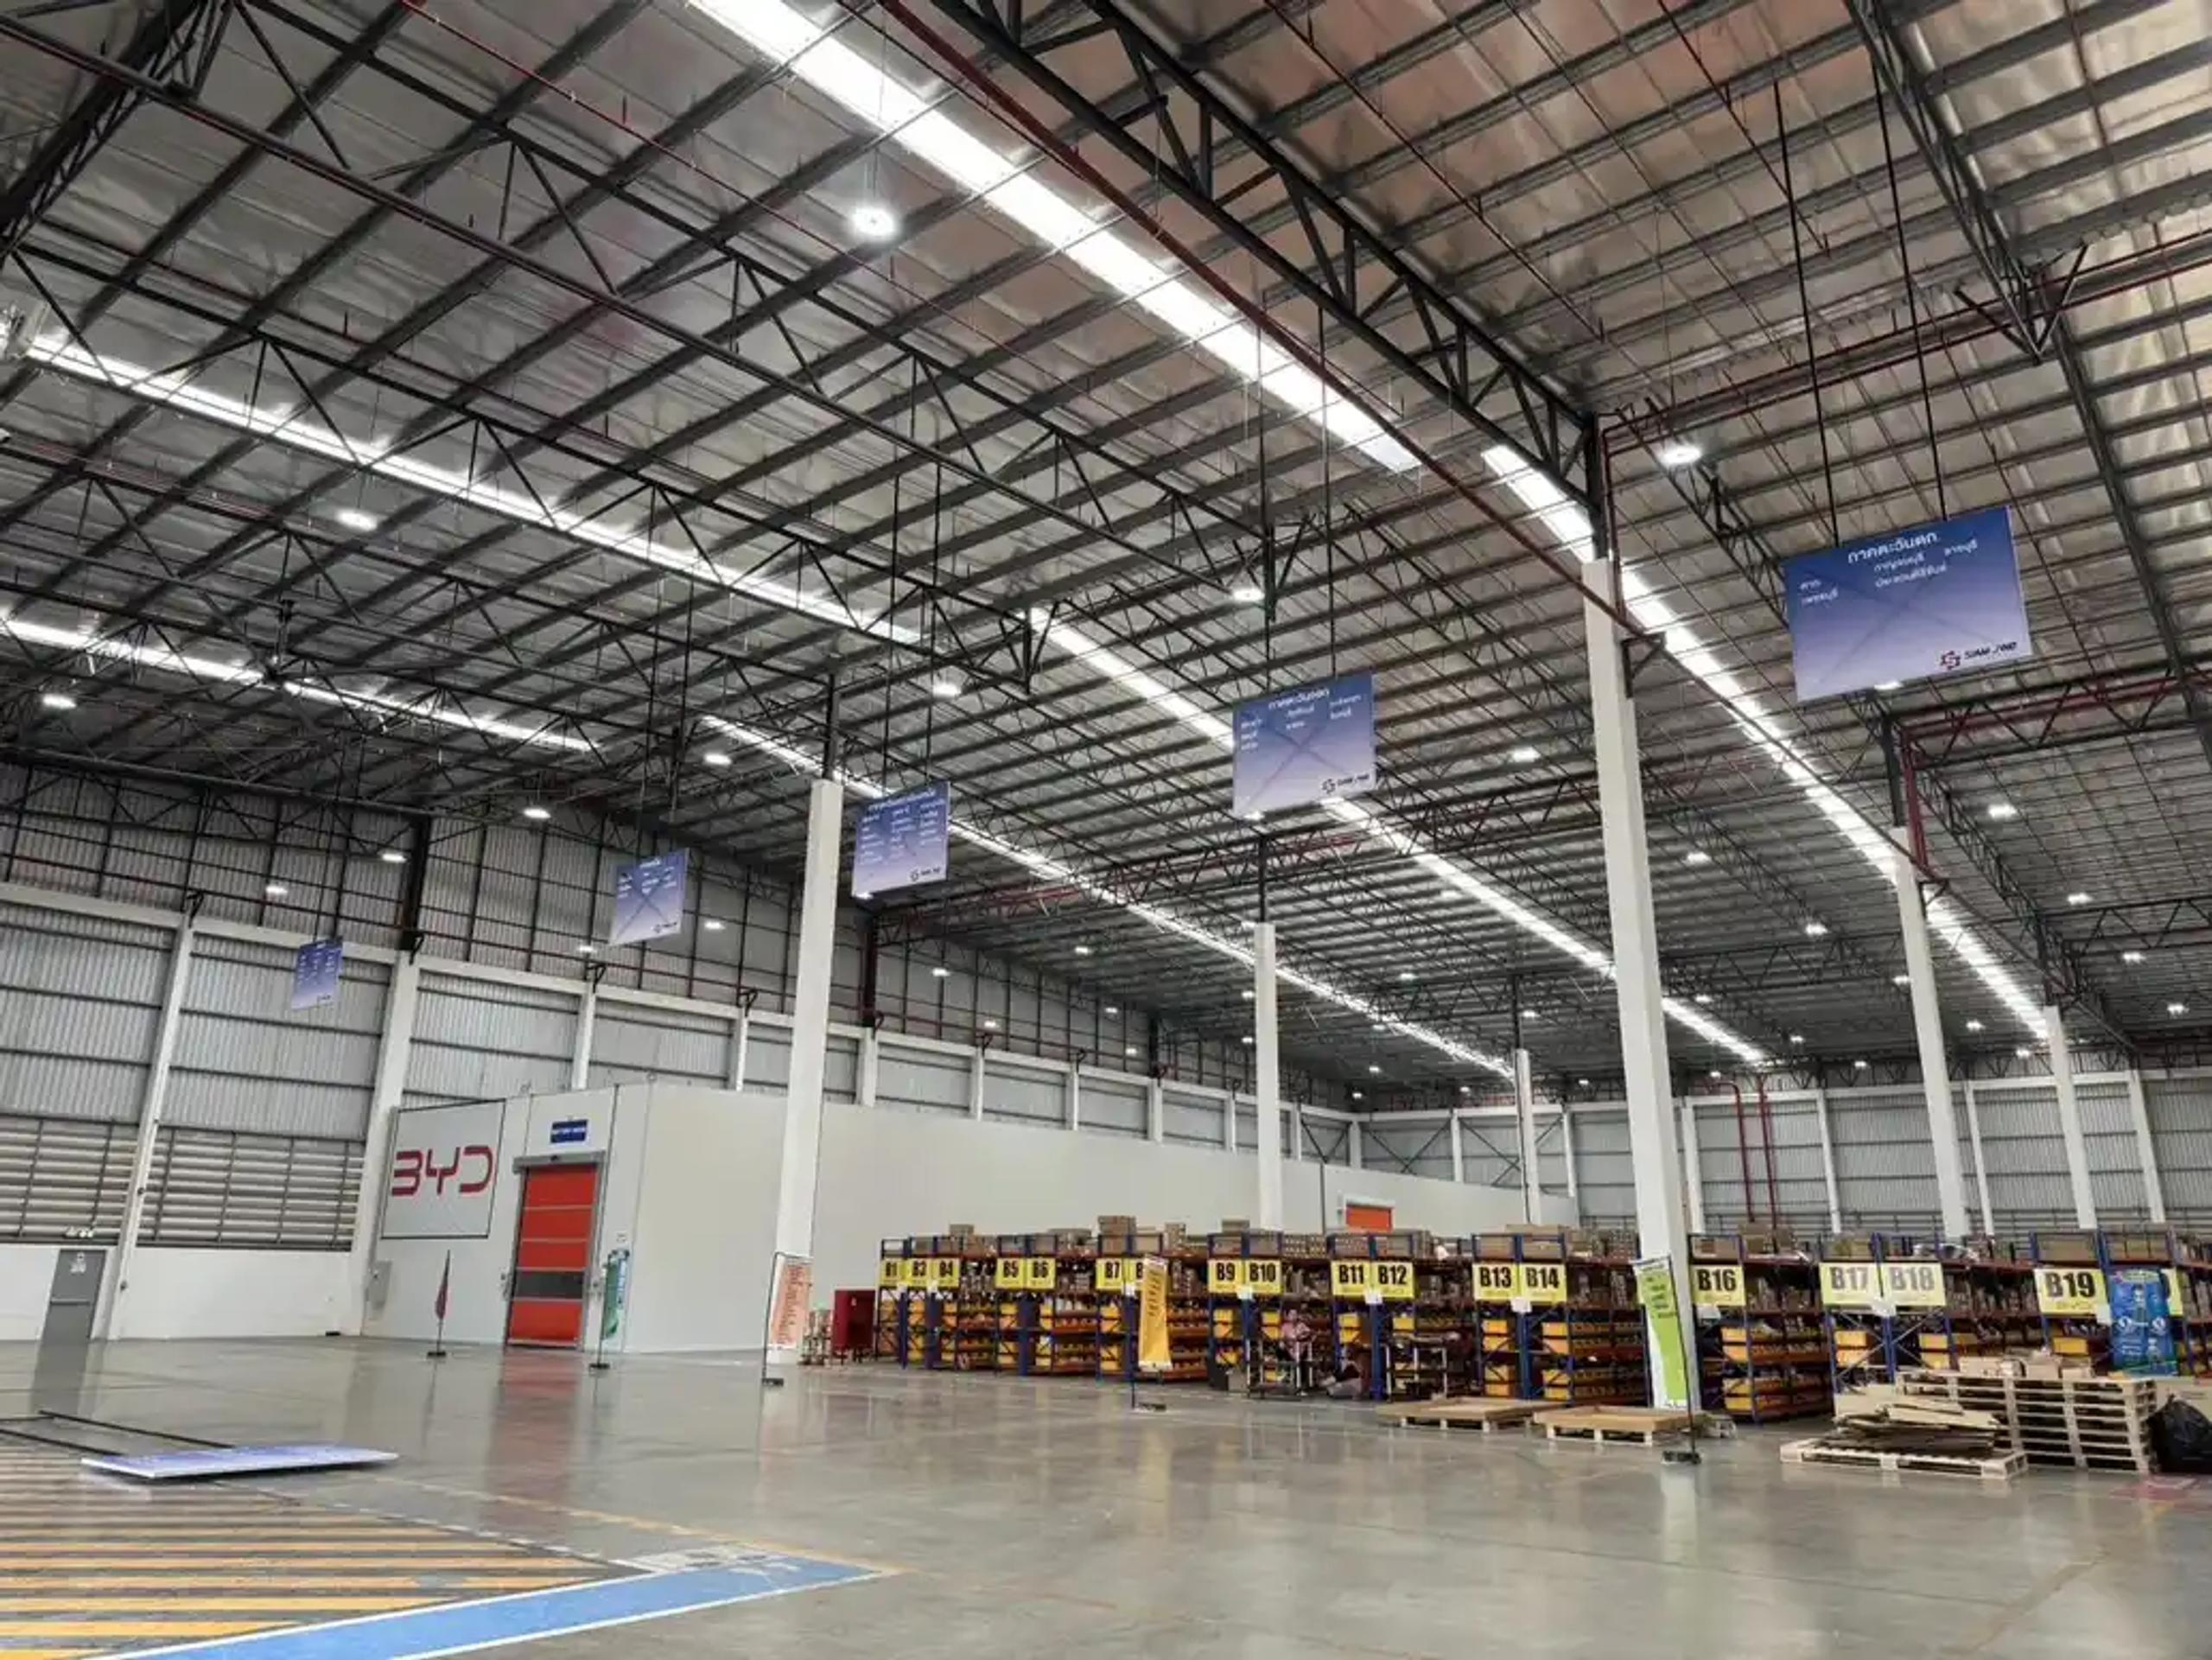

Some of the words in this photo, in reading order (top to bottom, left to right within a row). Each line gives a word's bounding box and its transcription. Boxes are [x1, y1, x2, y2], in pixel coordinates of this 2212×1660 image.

[391, 1146, 493, 1197] BYD
[1105, 1262, 1120, 1278] B7
[1217, 1262, 1236, 1282] B9
[1249, 1262, 1276, 1282] B10
[1338, 1264, 1364, 1284] B11
[1378, 1264, 1407, 1285] B12
[1479, 1267, 1512, 1288] B13
[1526, 1267, 1560, 1288] B14
[1697, 1269, 1737, 1292] B16
[1829, 1267, 1868, 1290] B17
[1889, 1267, 1936, 1290] B18
[2045, 1272, 2096, 1298] B19
